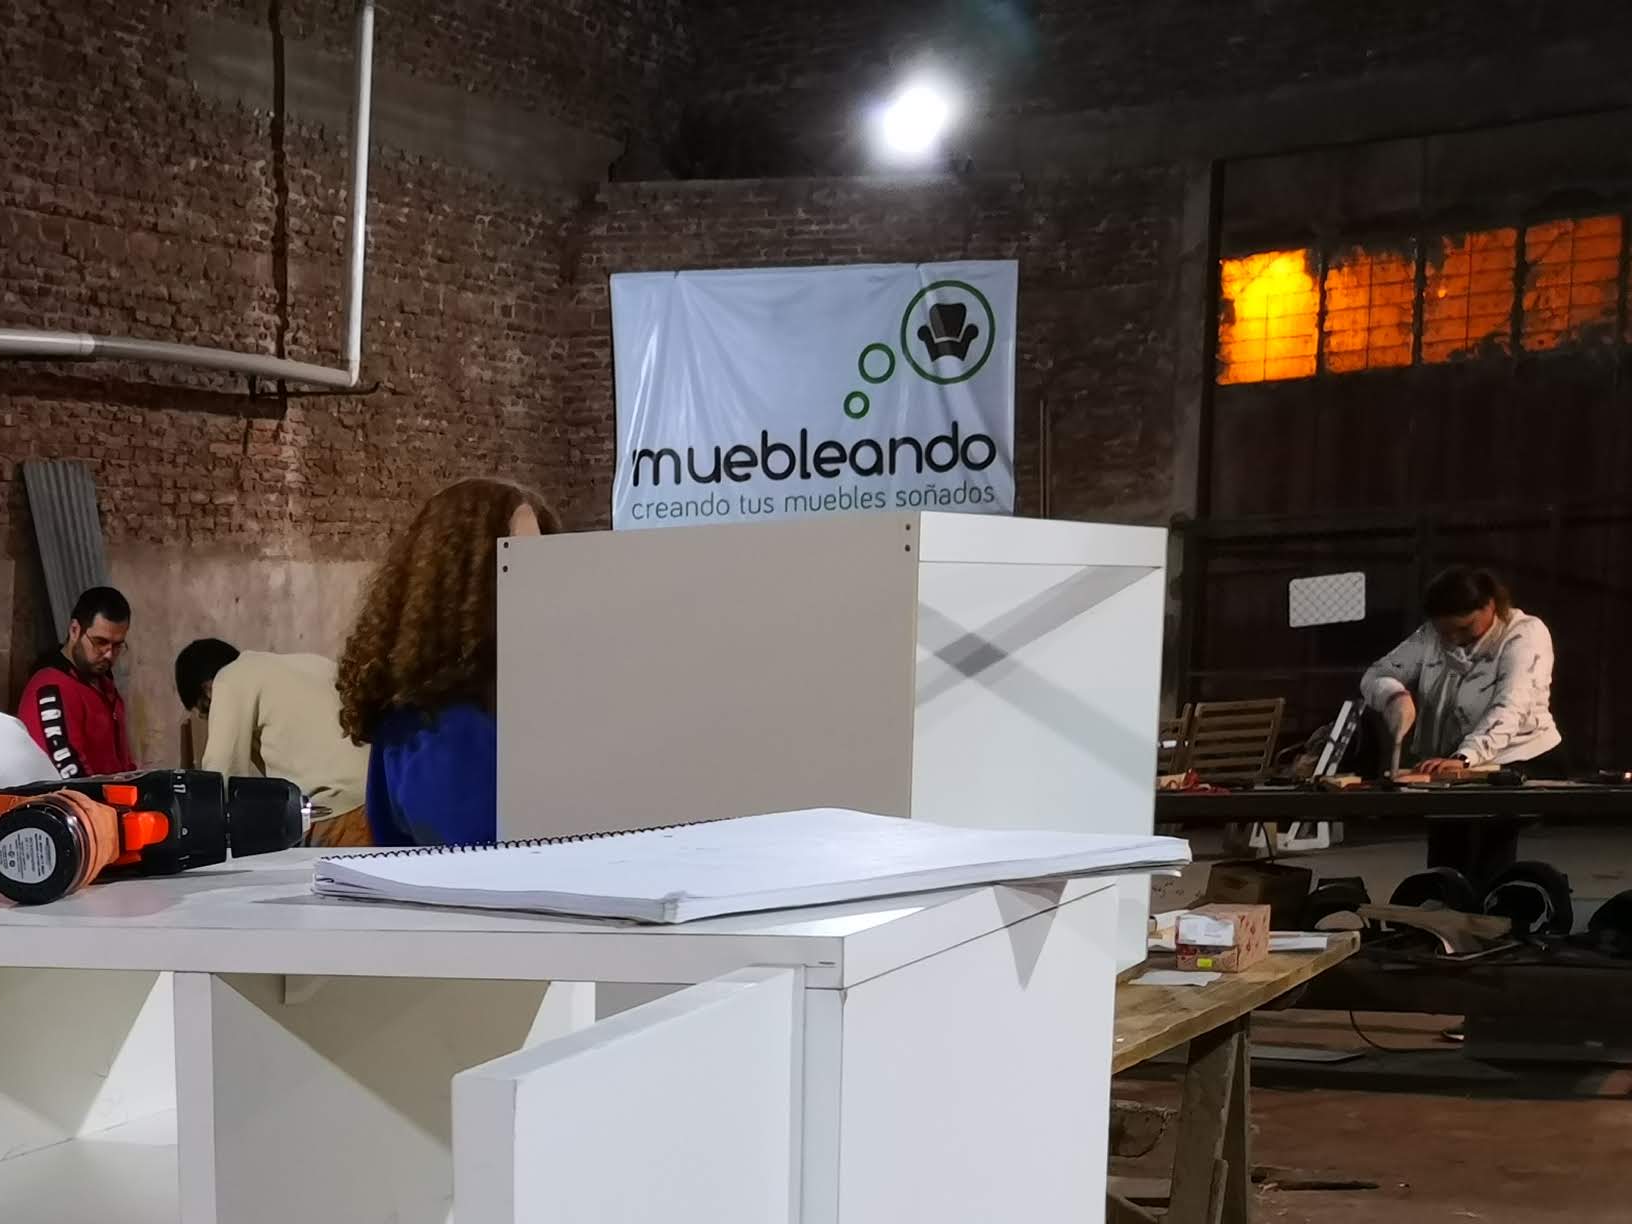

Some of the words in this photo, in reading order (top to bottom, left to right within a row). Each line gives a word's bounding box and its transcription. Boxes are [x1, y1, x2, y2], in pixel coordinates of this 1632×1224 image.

[632, 421, 997, 487] muebleando
[631, 492, 730, 521] creando
[739, 496, 775, 515] tus
[784, 486, 886, 513] muebles
[895, 480, 995, 508] soñados
